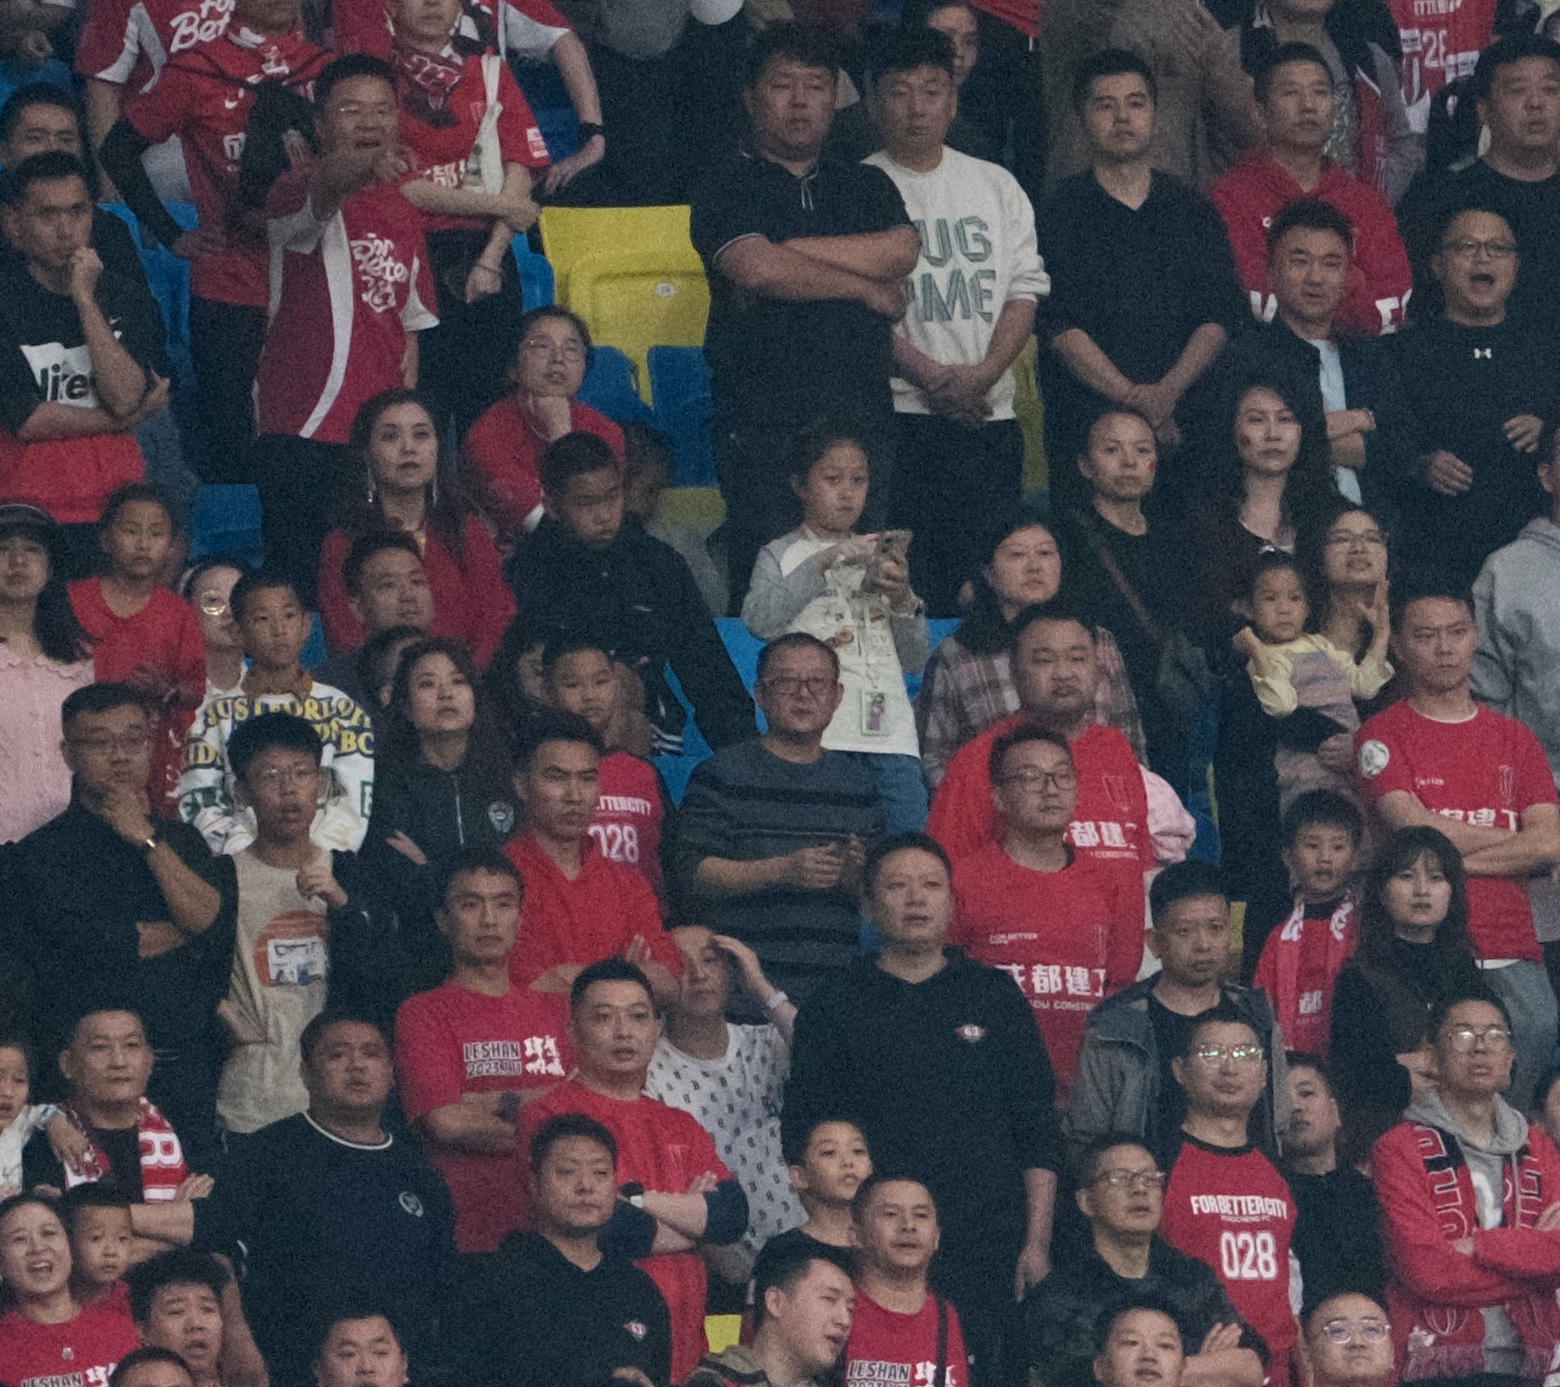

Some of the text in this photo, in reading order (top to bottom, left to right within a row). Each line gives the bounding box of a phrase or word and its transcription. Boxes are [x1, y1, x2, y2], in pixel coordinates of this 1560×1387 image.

[464, 1041, 521, 1061] LESHAN
[1220, 1230, 1277, 1279] 028
[847, 1360, 910, 1382] LESHAN
